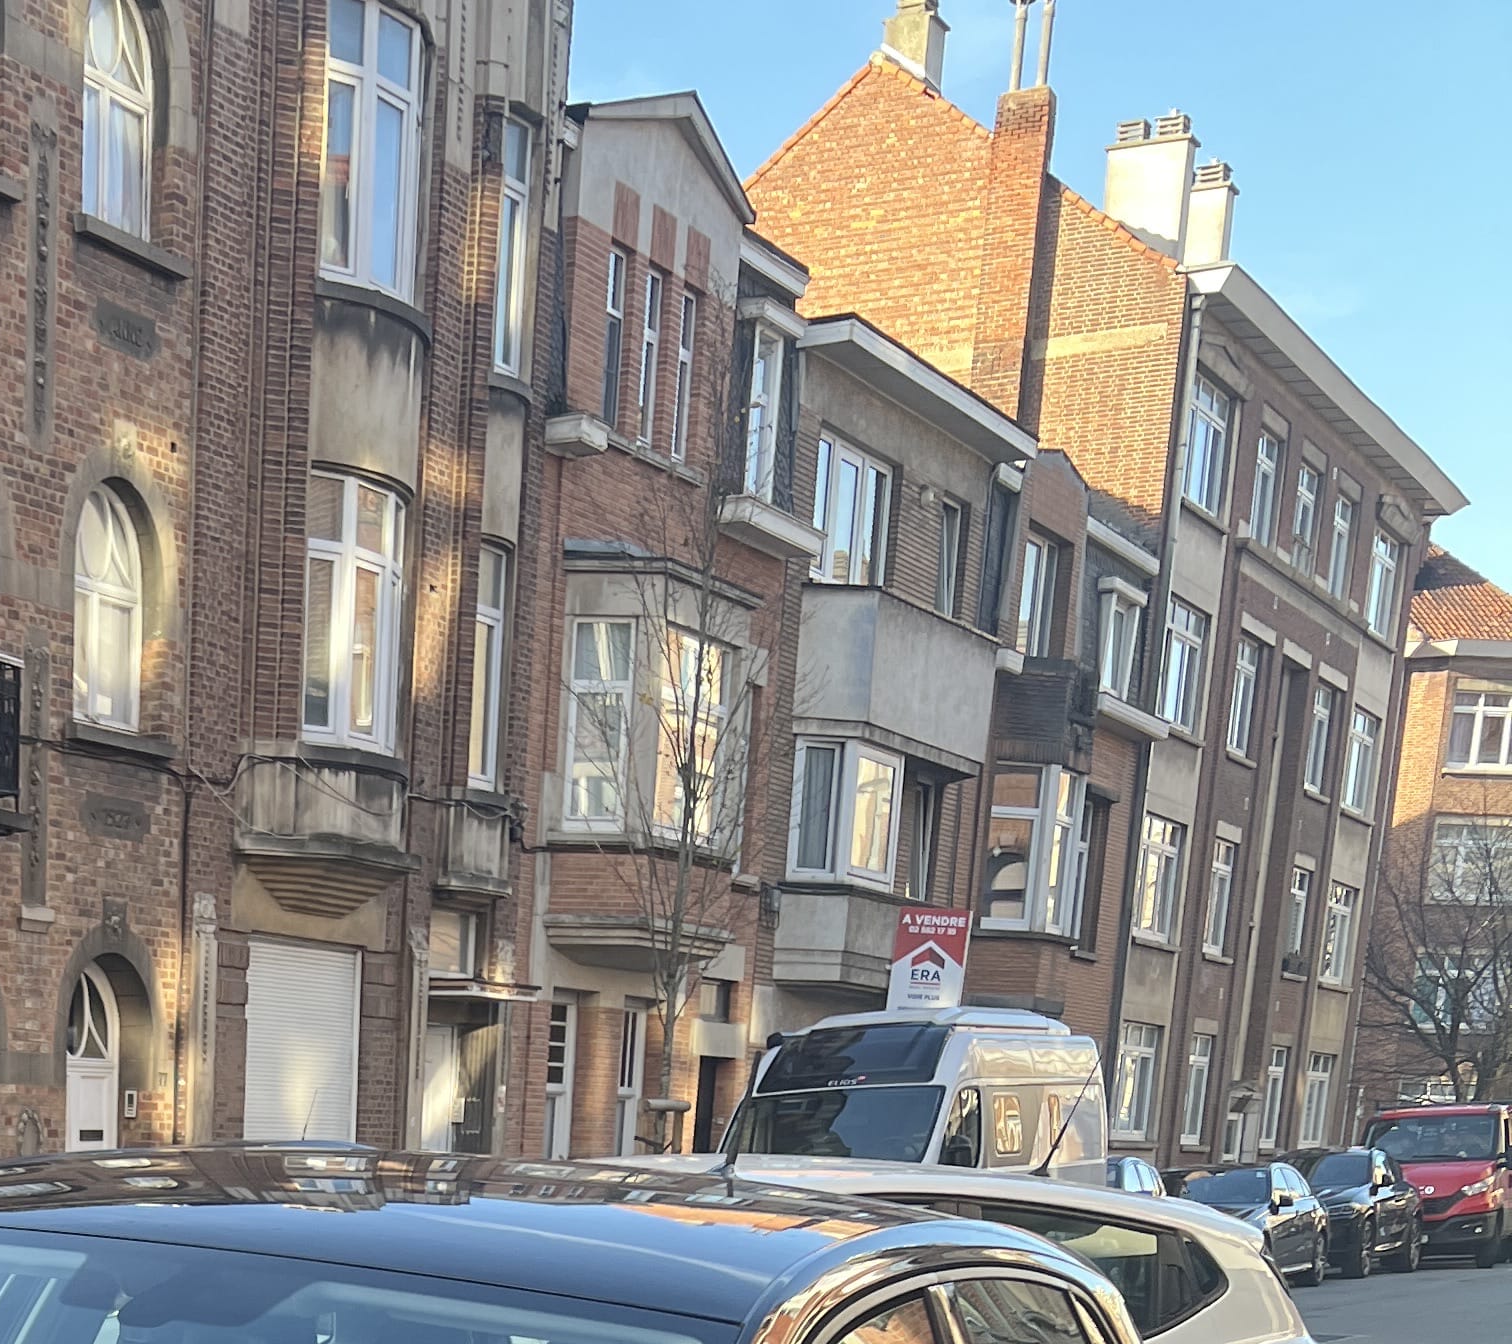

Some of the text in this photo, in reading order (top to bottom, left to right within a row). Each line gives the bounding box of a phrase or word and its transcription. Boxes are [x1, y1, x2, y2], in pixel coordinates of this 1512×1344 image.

[902, 914, 967, 927] A VENDRE
[911, 969, 941, 981] ERA
